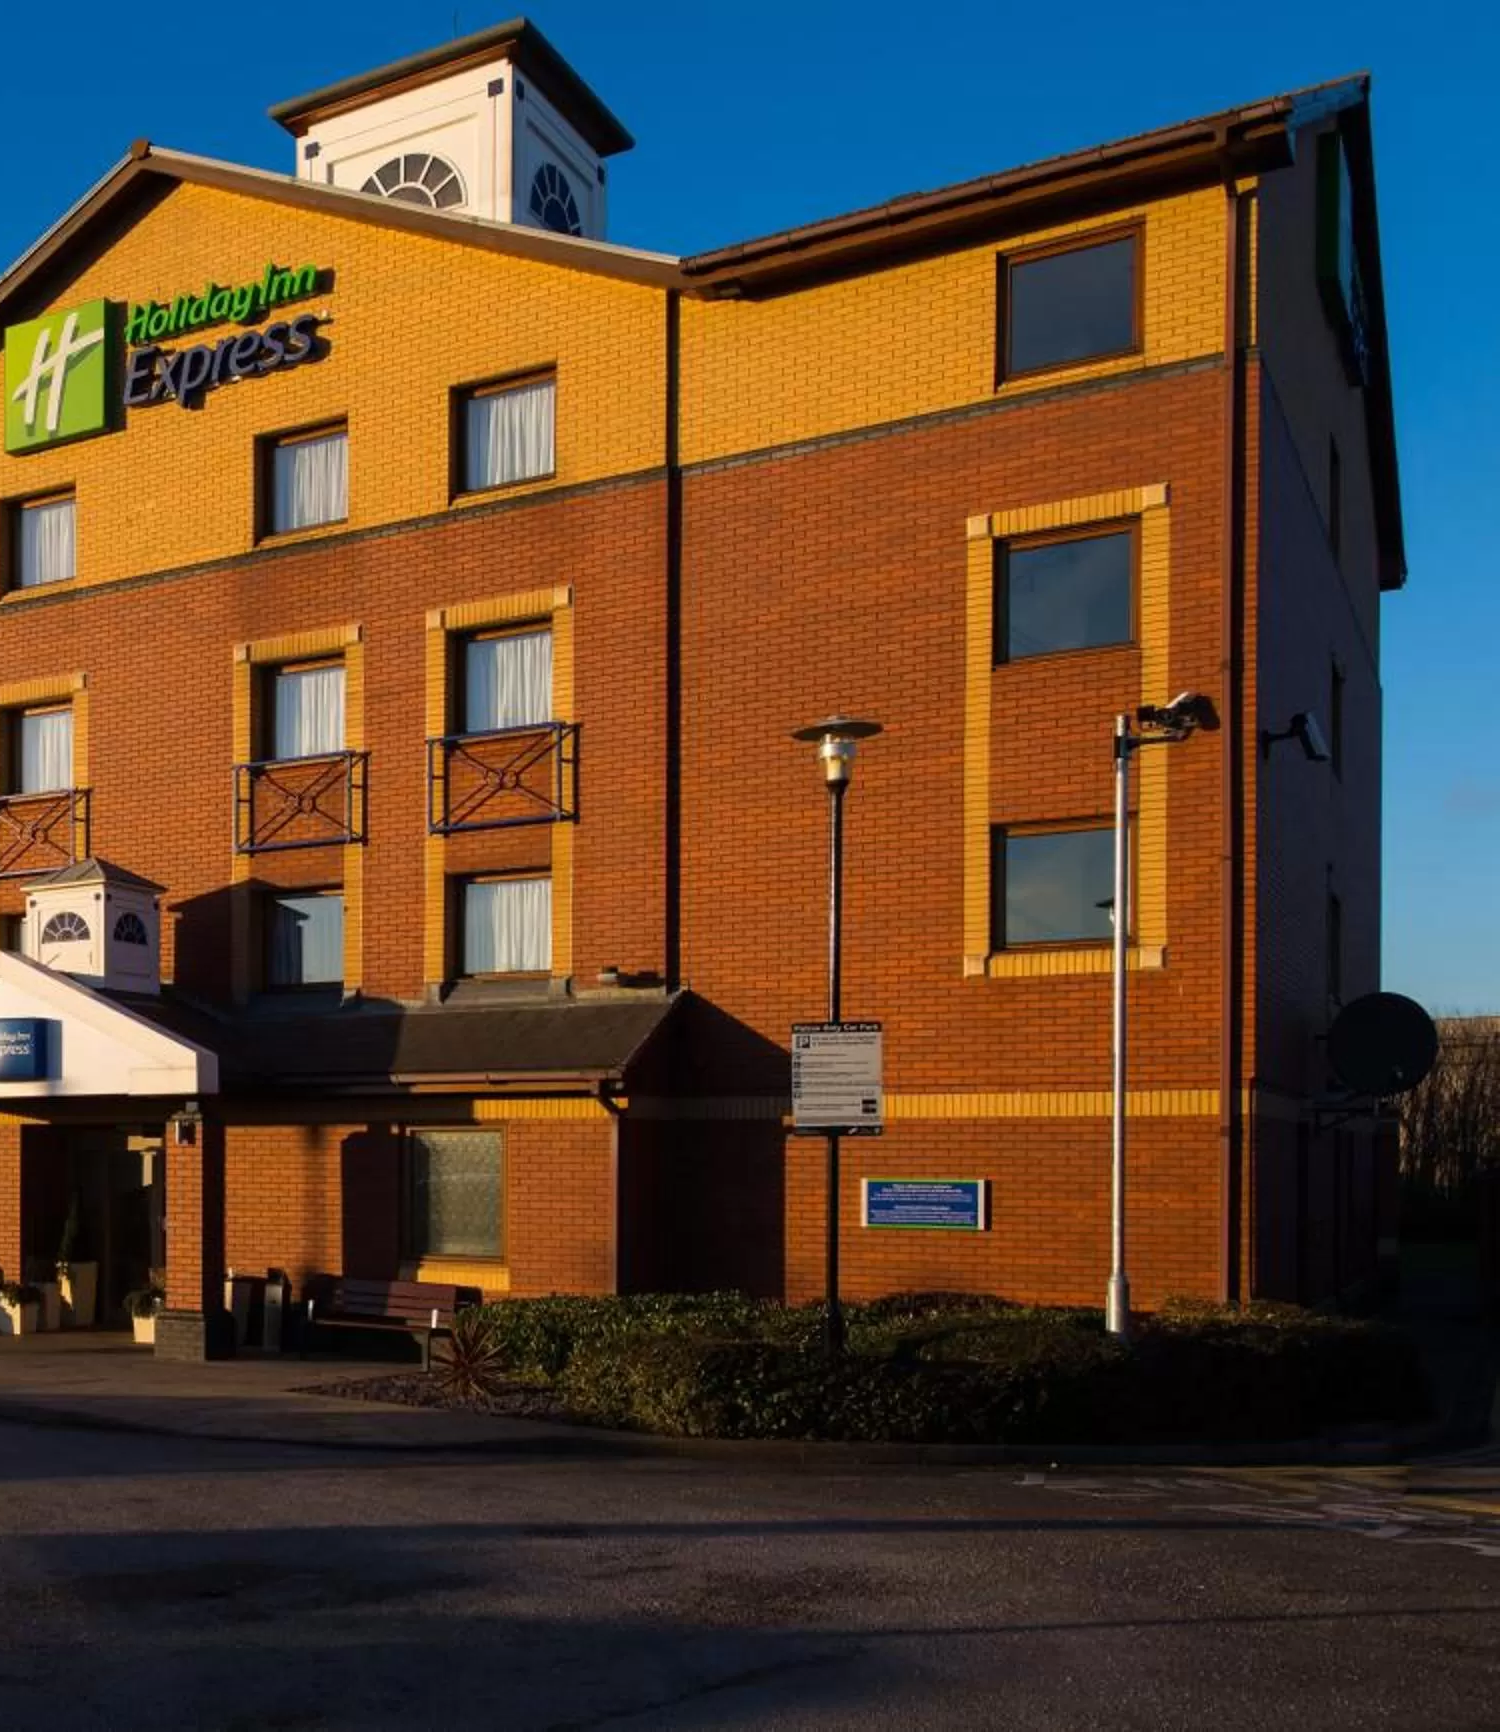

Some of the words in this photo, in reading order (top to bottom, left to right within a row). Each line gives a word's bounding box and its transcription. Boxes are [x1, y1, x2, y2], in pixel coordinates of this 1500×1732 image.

[125, 280, 259, 344] Holiday
[258, 258, 317, 306] Inn
[123, 313, 313, 406] Express
